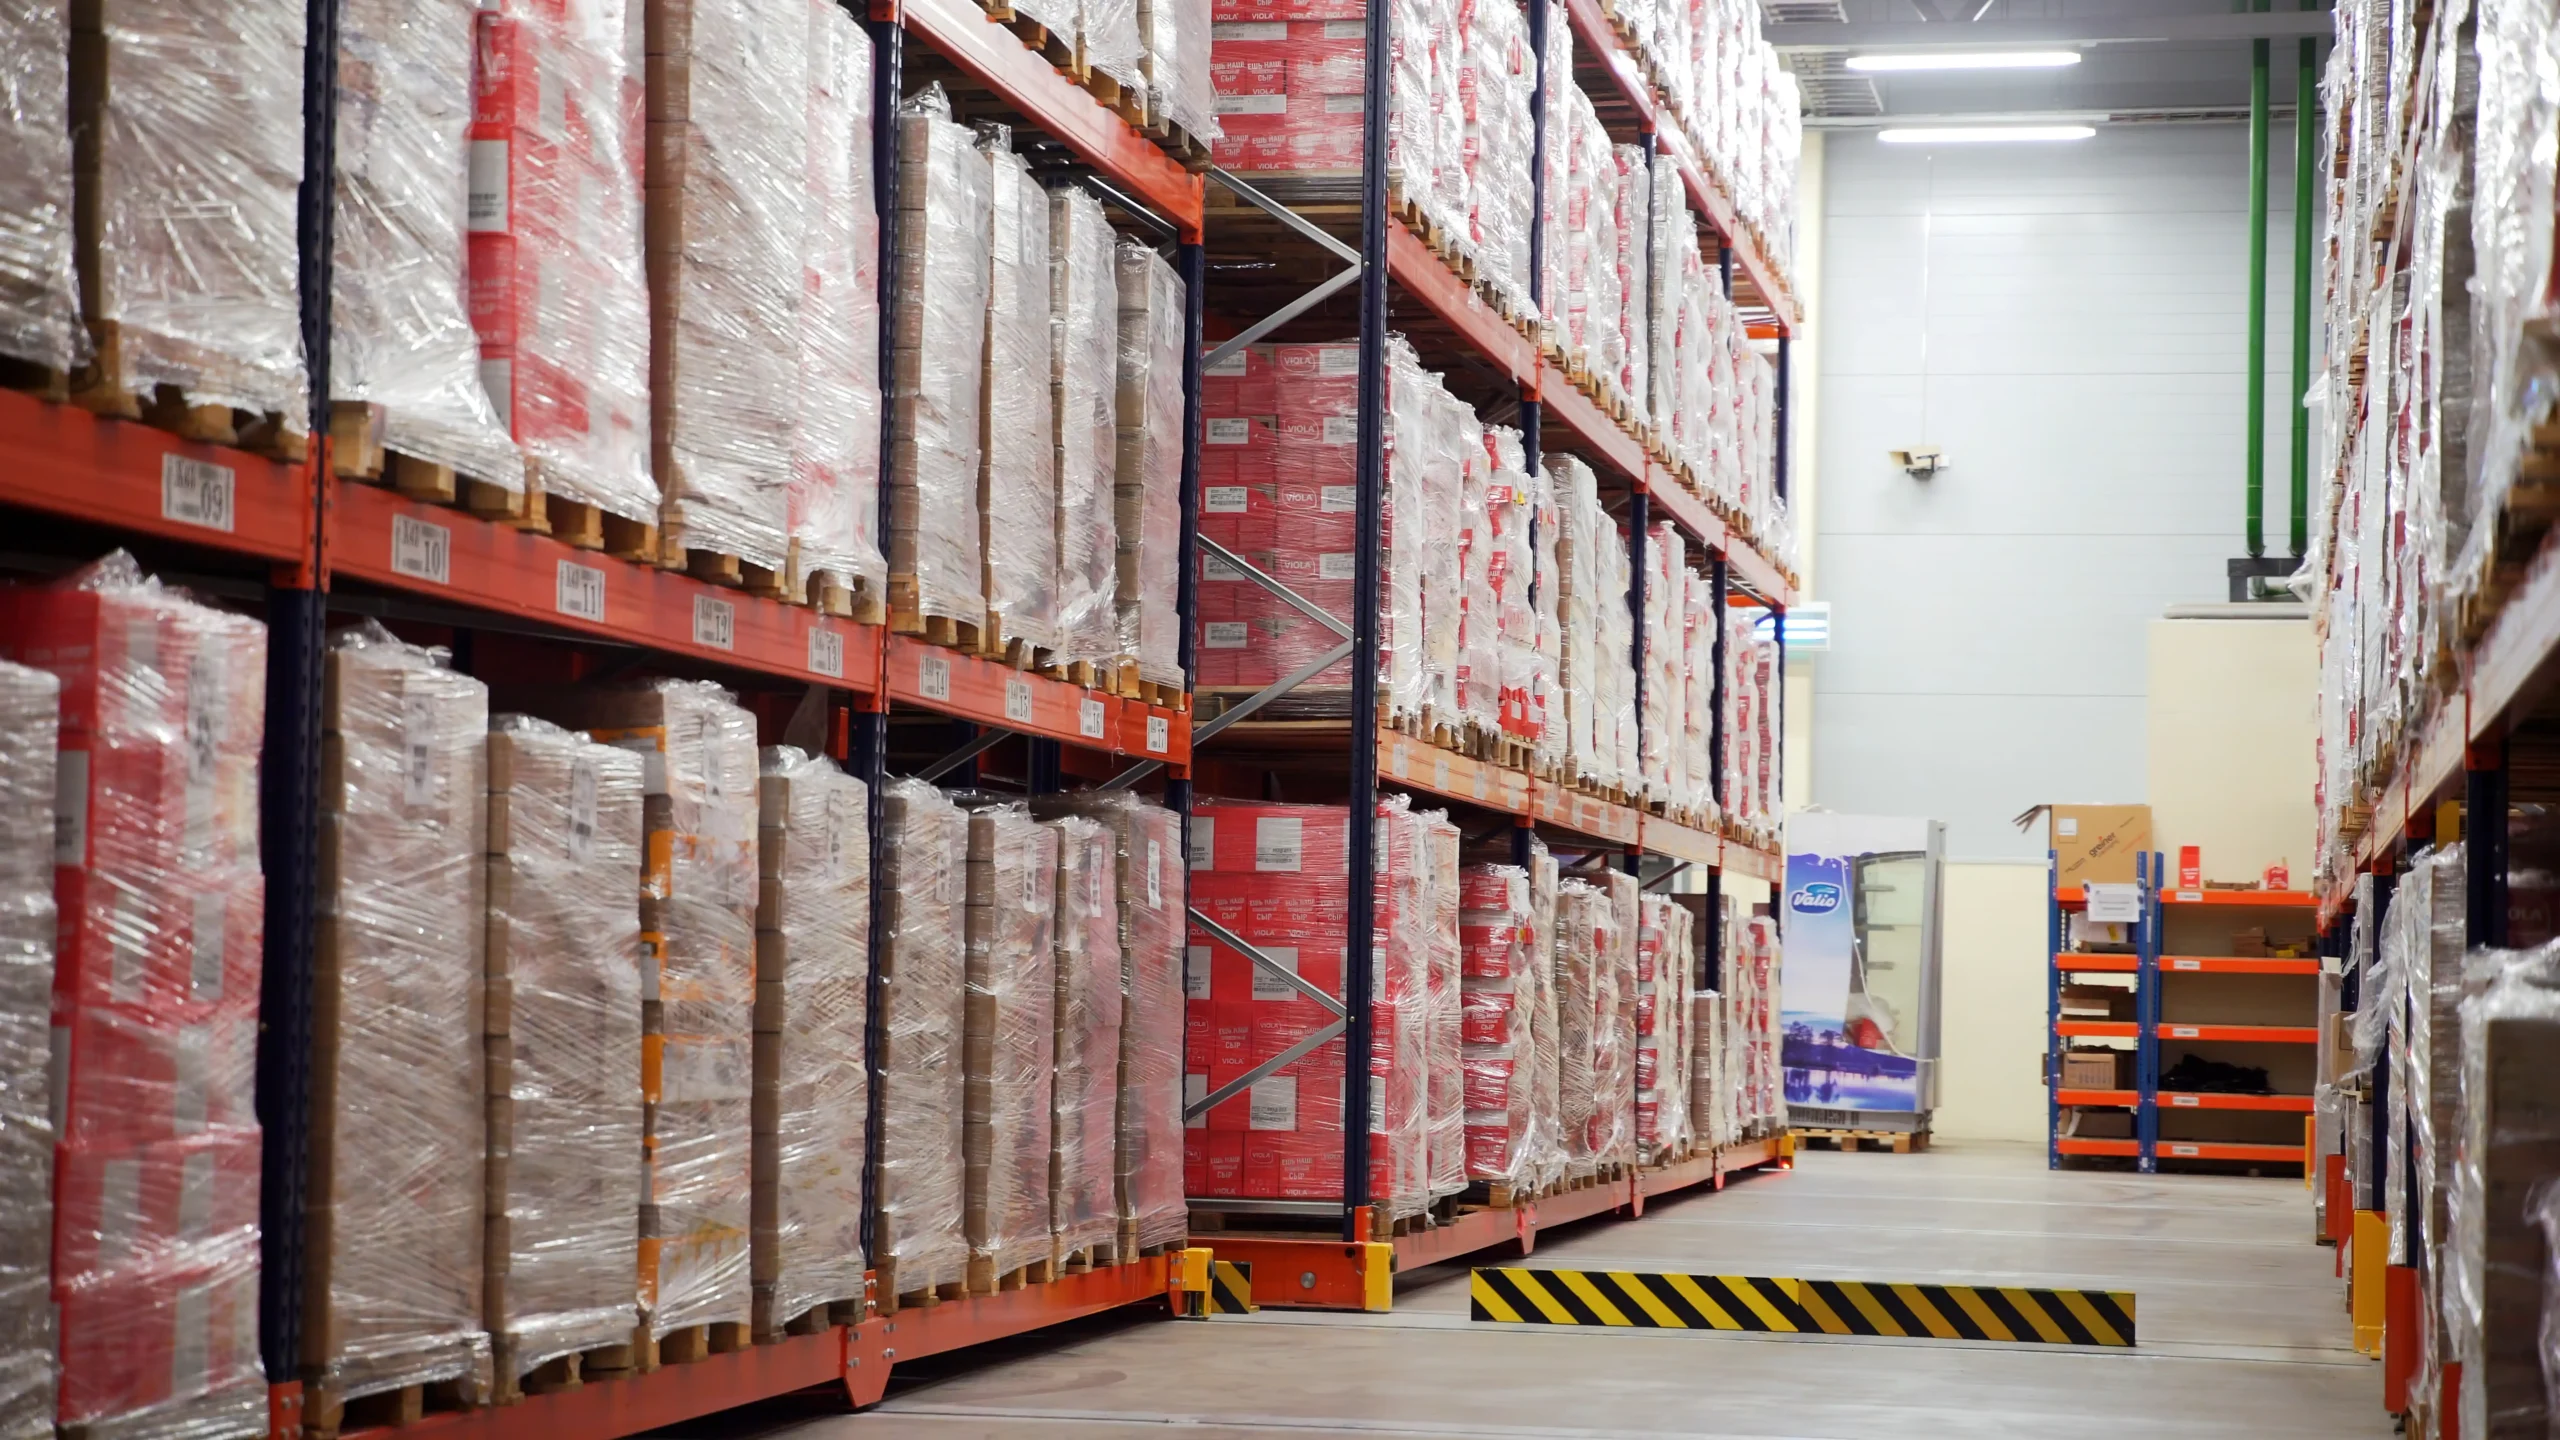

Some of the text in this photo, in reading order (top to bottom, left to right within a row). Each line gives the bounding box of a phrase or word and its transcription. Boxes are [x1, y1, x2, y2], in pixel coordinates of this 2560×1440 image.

[1284, 357, 1310, 365] VIOLA
[200, 482, 223, 522] 09
[1286, 494, 1314, 502] VIOLA
[425, 540, 441, 576] 10
[583, 583, 596, 615] 11
[2088, 832, 2116, 858] greiner
[1793, 893, 1837, 908] Valio
[1222, 912, 1237, 920] СЫР
[1289, 1172, 1304, 1180] СЫР
